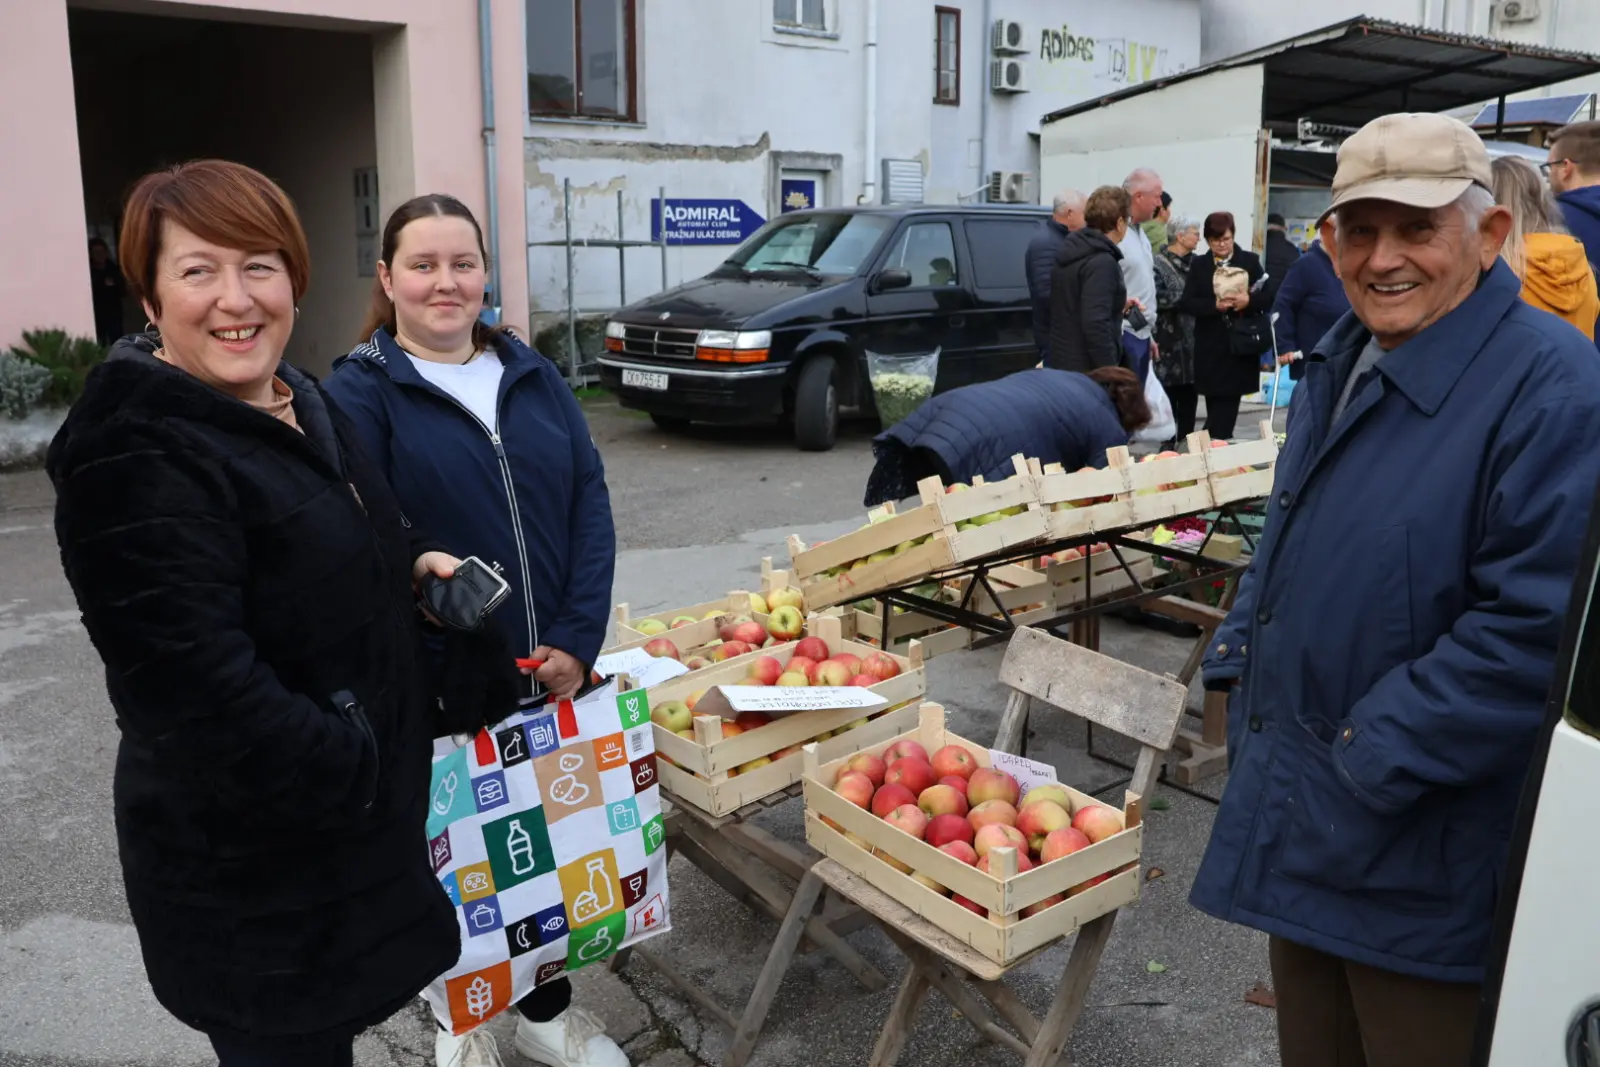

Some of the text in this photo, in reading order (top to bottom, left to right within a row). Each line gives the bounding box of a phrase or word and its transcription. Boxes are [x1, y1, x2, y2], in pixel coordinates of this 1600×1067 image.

[663, 205, 741, 223] ADMIRAL
[677, 220, 728, 228] AUTOMAT CLUB
[660, 228, 741, 239] TRAŽNJI ULAZ DESNO
